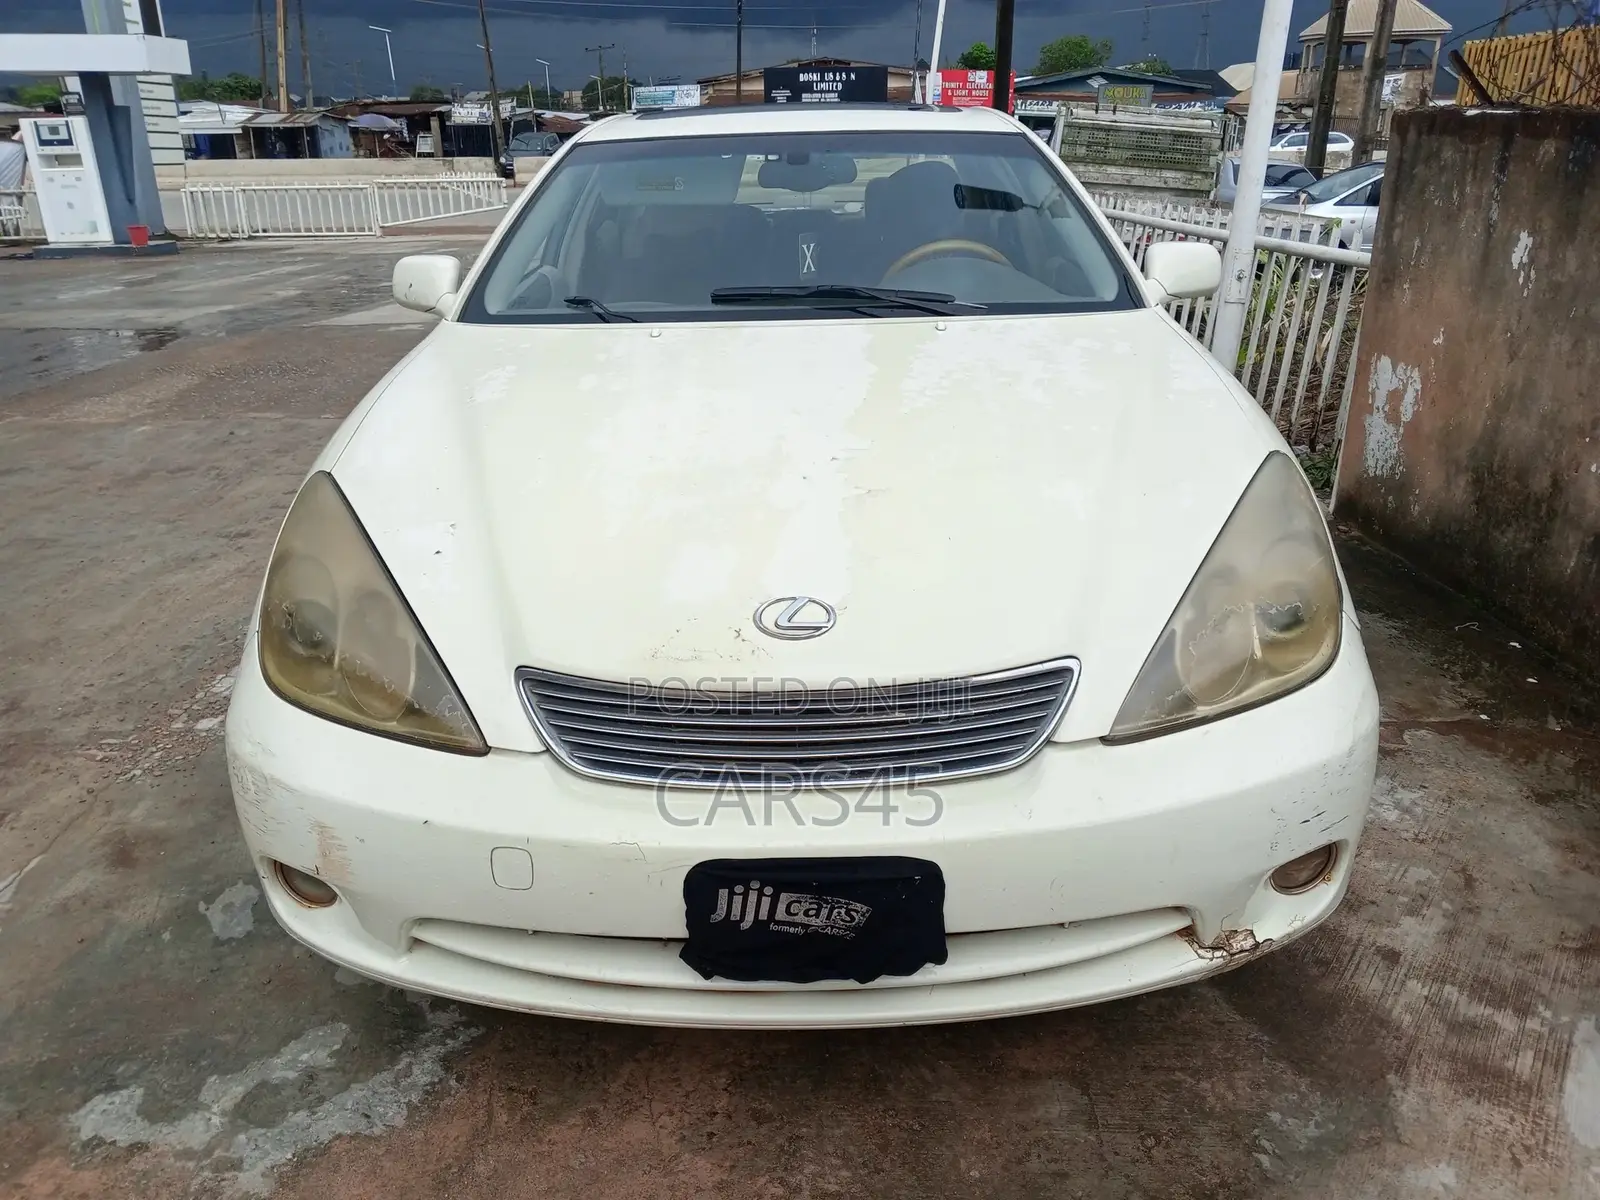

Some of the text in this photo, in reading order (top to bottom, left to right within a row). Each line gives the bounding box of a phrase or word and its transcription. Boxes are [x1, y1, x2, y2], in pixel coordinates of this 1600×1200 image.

[1103, 87, 1146, 98] MOUKA
[710, 880, 862, 930] Jiji cars
[768, 922, 806, 936] formerly
